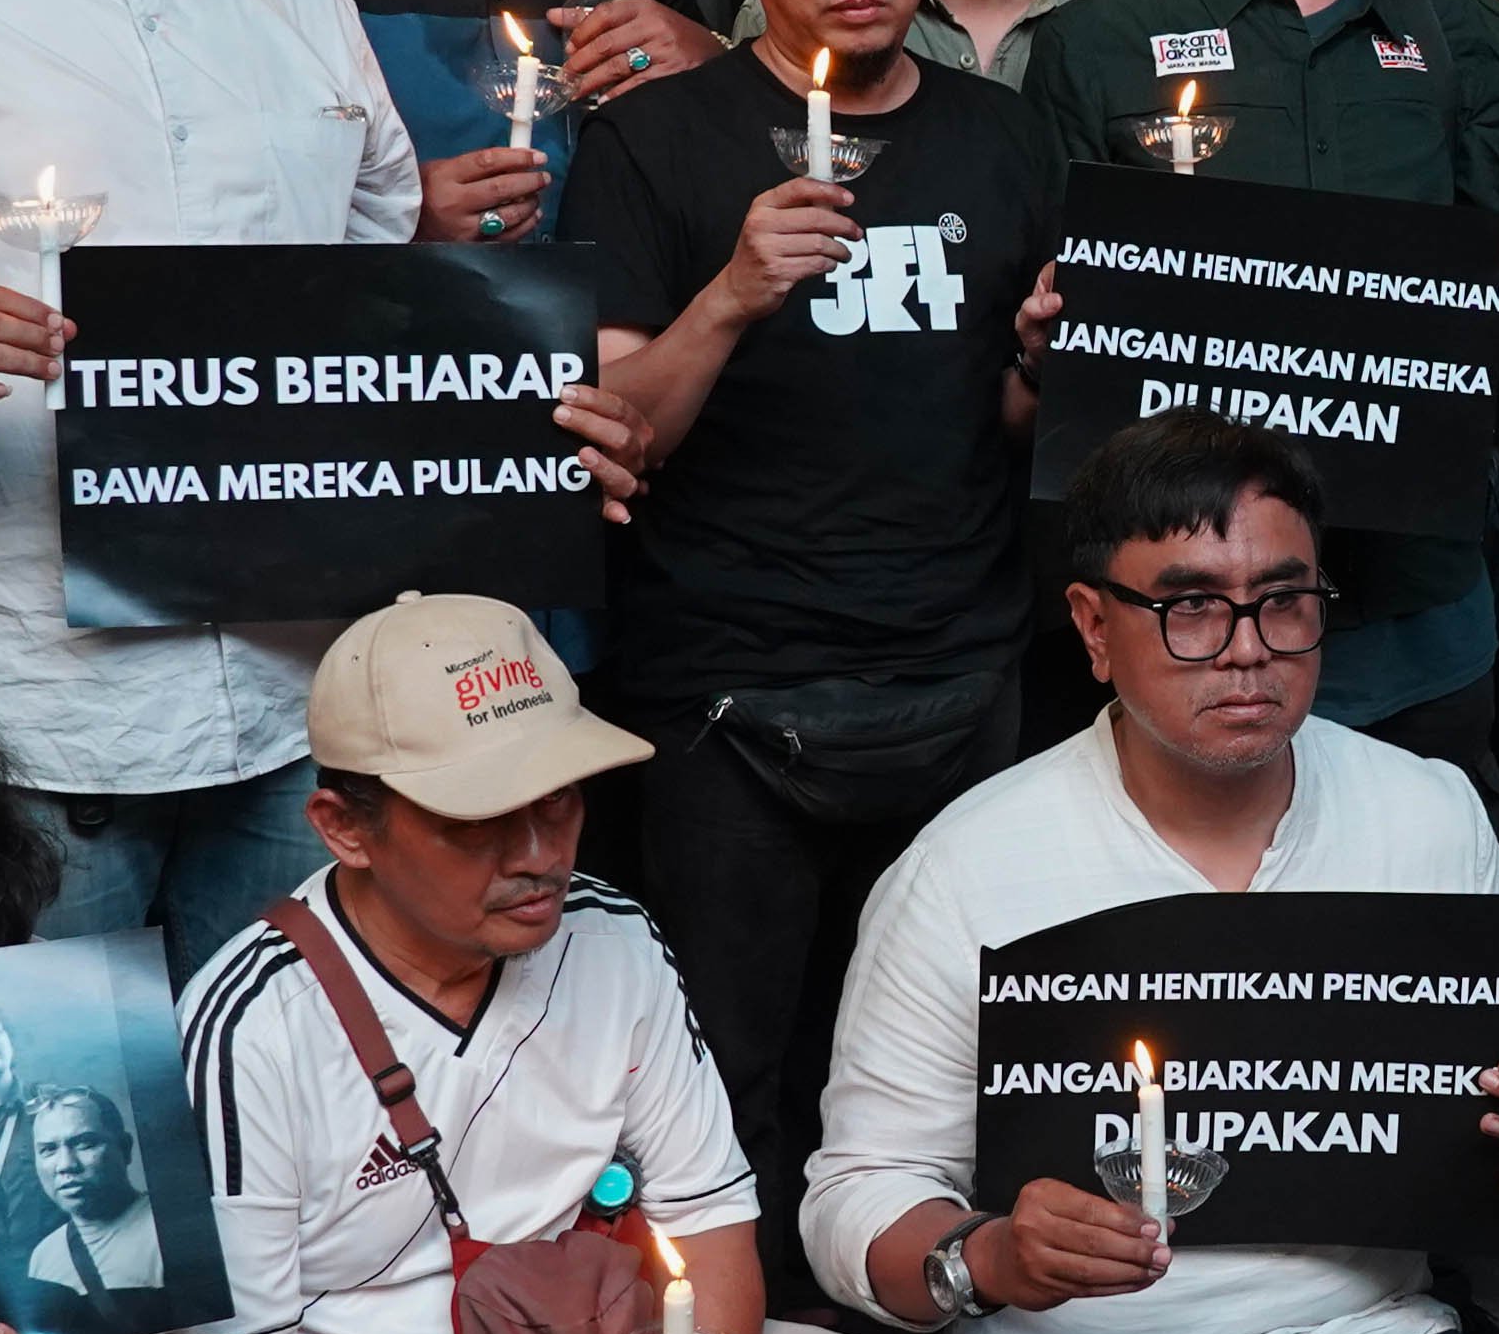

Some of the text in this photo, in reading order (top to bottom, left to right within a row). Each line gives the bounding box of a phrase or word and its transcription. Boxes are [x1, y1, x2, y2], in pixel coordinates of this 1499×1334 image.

[1056, 236, 1186, 276] JANGAN
[1193, 253, 1341, 295] HENTIKAN
[70, 352, 584, 409] TERUS BERHARAP
[1050, 320, 1493, 397] JANGAN BIARKAN MEREKA
[72, 456, 591, 506] BAWA MEREKA PULANG
[455, 653, 543, 710] giving
[466, 711, 489, 727] for
[981, 973, 1130, 1004] JANGAN
[1139, 972, 1313, 1001] HENTIKAN
[1164, 1060, 1341, 1093] BIARKAN
[1350, 1061, 1488, 1098] MEREK
